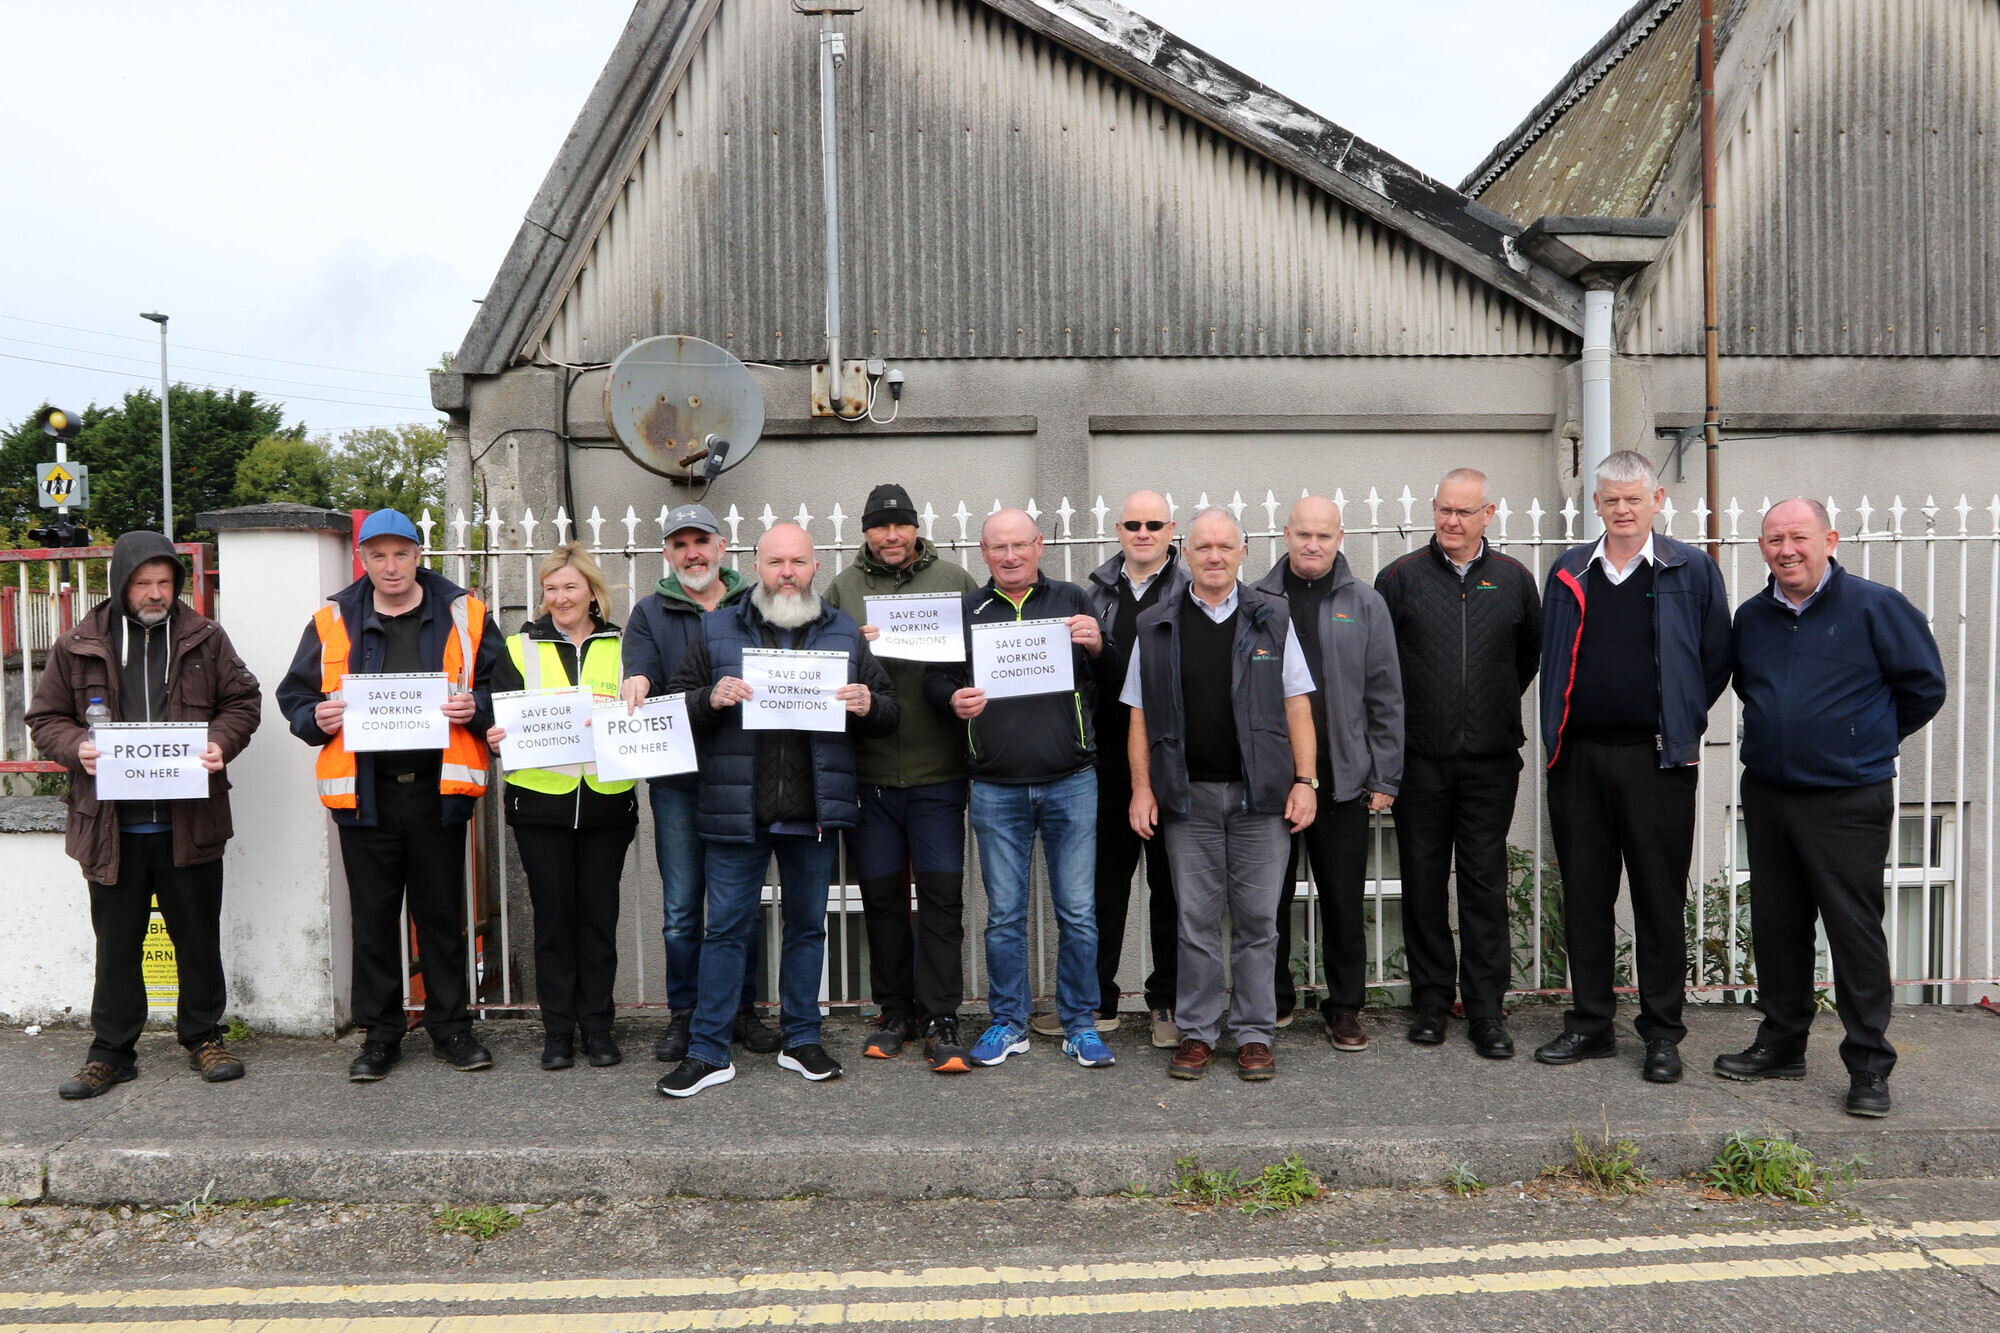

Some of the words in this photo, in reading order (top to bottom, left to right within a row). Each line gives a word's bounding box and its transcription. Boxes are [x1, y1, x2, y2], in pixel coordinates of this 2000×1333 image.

[889, 611, 915, 620] SAVE
[918, 610, 939, 618] OUR
[890, 623, 940, 632] WORKING
[885, 636, 947, 646] CONDITIONS
[996, 639, 1022, 650] SAVE
[1024, 637, 1046, 647] OUR
[996, 651, 1048, 664] WORKING
[768, 670, 796, 680] SAVE
[799, 670, 822, 680] OUR
[990, 665, 1056, 680] CONDITIONS
[600, 682, 617, 690] FBD
[768, 685, 821, 695] WORKING
[368, 691, 396, 700] SAVE
[400, 690, 422, 700] OUR
[369, 705, 423, 716] WORKING
[760, 700, 828, 711] CONDITIONS
[521, 707, 548, 718] SAVE
[550, 706, 572, 716] OUR
[362, 720, 430, 730] CONDITIONS
[522, 720, 572, 734] WORKING
[607, 716, 673, 735] PROTEST
[517, 735, 580, 749] CONDITIONS
[114, 744, 190, 758] PROTEST
[618, 744, 638, 755] ON
[641, 742, 668, 754] HERE
[125, 769, 145, 779] ON
[150, 768, 180, 778] HERE
